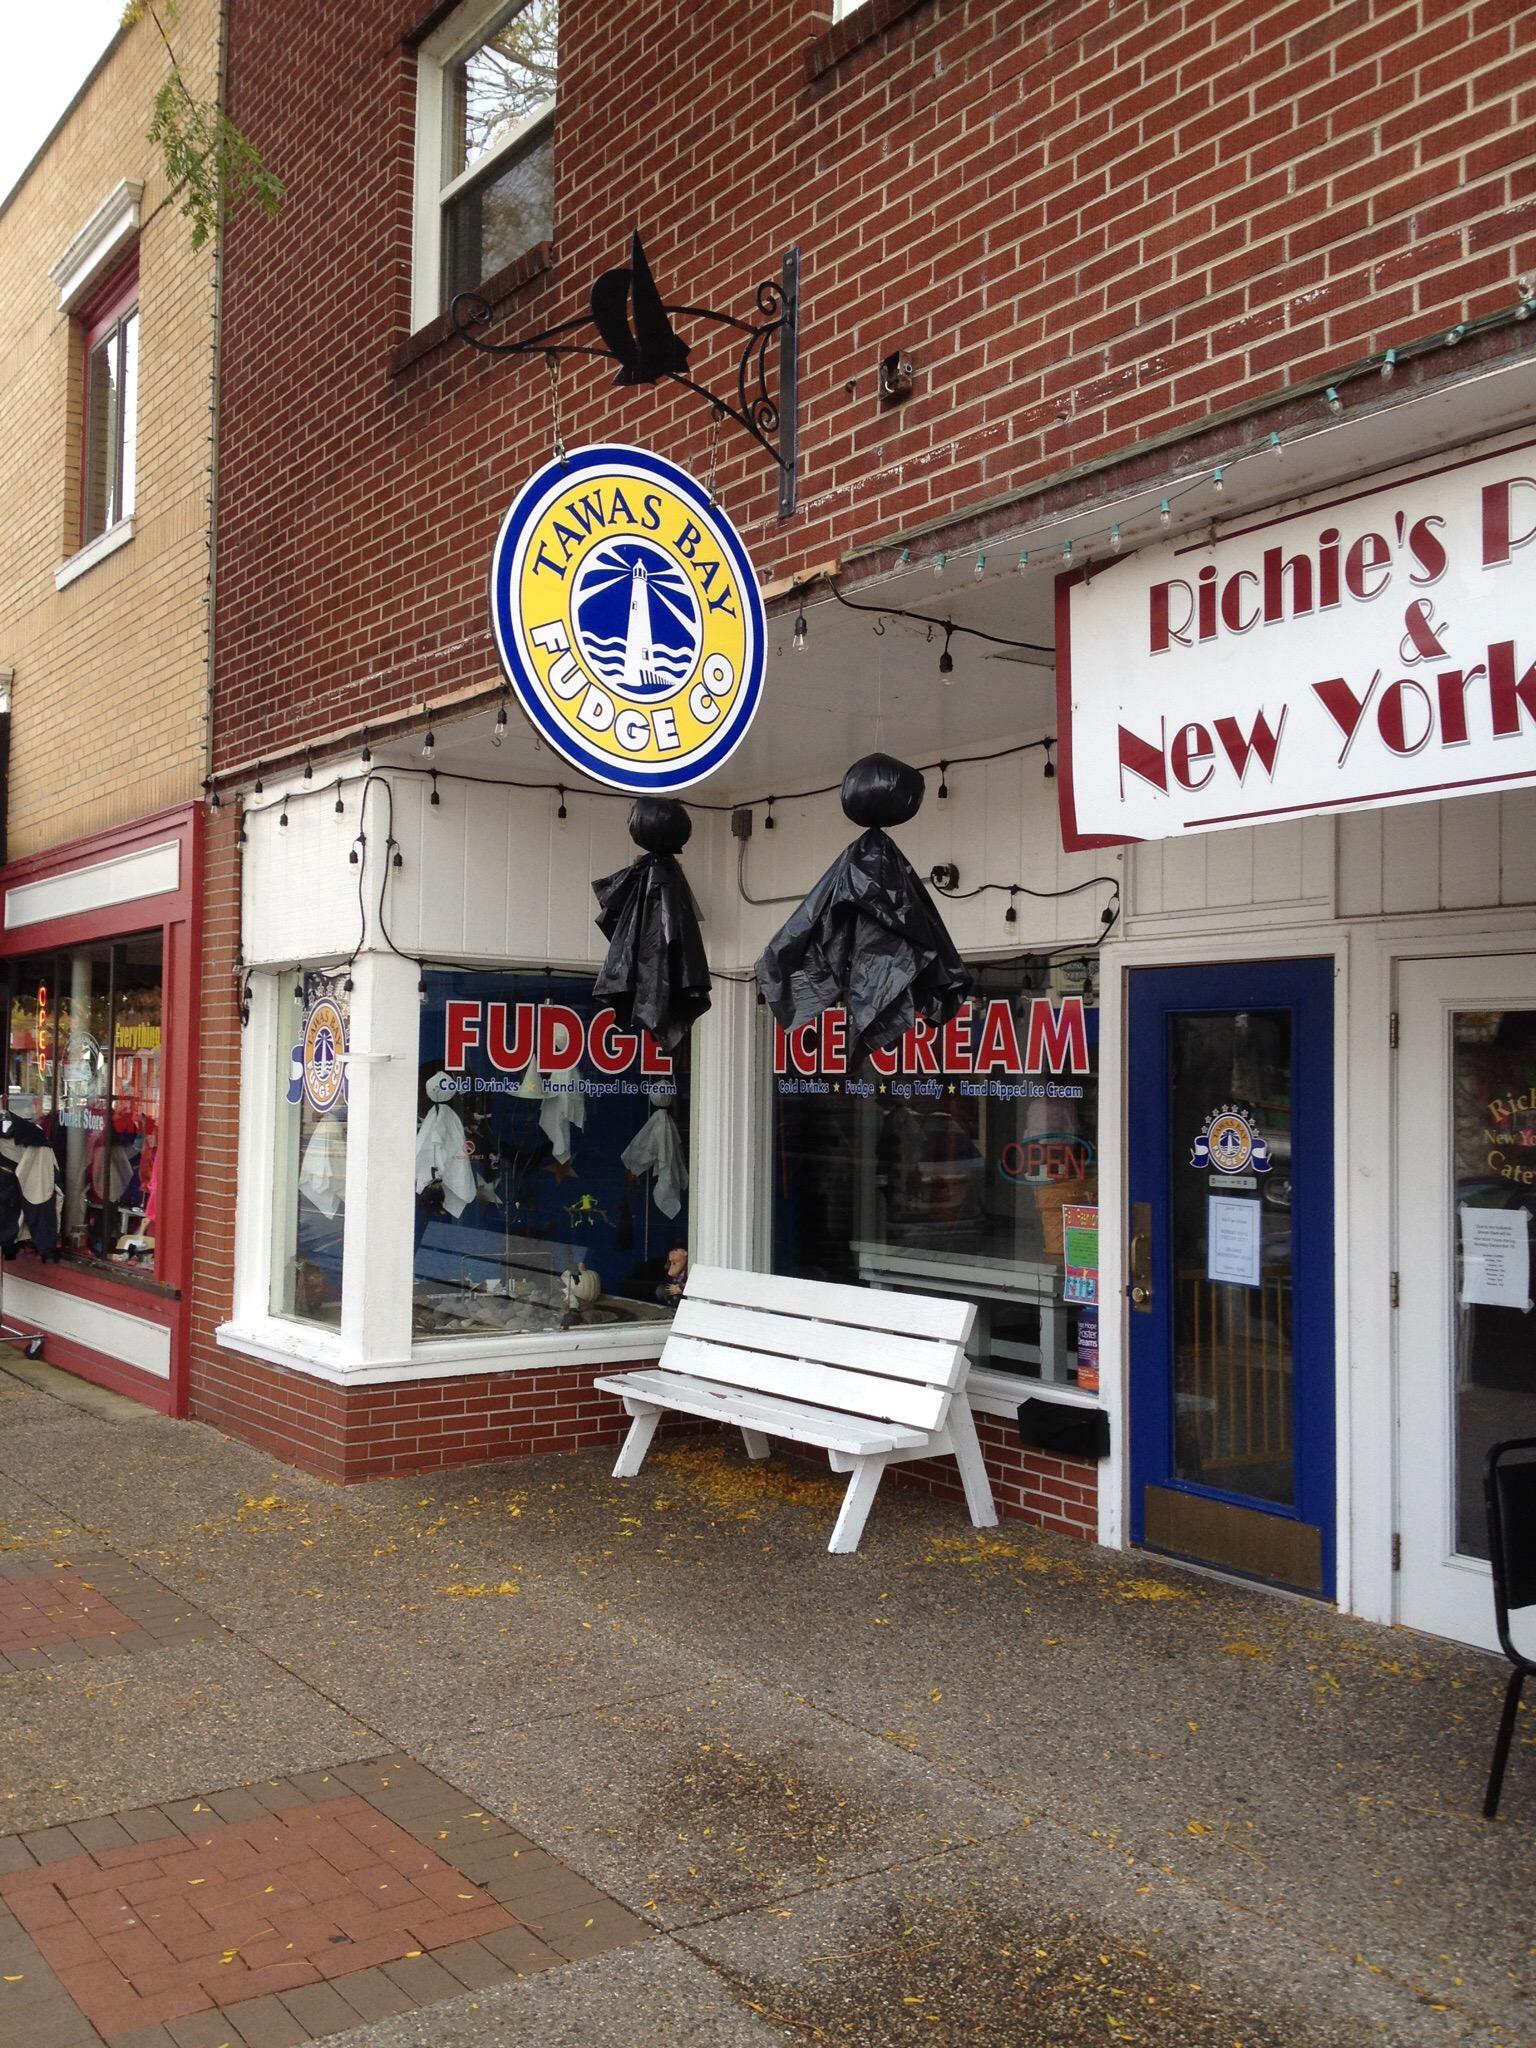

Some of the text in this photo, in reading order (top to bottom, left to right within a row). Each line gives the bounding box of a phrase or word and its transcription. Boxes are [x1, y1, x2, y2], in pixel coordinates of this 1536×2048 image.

[532, 488, 737, 619] TAWAS BAY
[1150, 510, 1447, 656] Richie's
[1399, 597, 1450, 665] &
[530, 619, 735, 752] FUDGE CO
[1117, 640, 1536, 802] New York
[444, 1000, 673, 1075] FUDGE
[773, 1005, 847, 1075] ICE
[83, 1108, 105, 1131] Store
[439, 1077, 677, 1097] Cold Drinks Hand Dipped Ice Cream
[778, 1079, 1083, 1100] Cold Drinks Fudge Log Taffy Hand Dipped Ice Cream
[1002, 1142, 1086, 1180] OPEN
[1484, 1129, 1515, 1145] New
[1488, 1150, 1536, 1184] Cate
